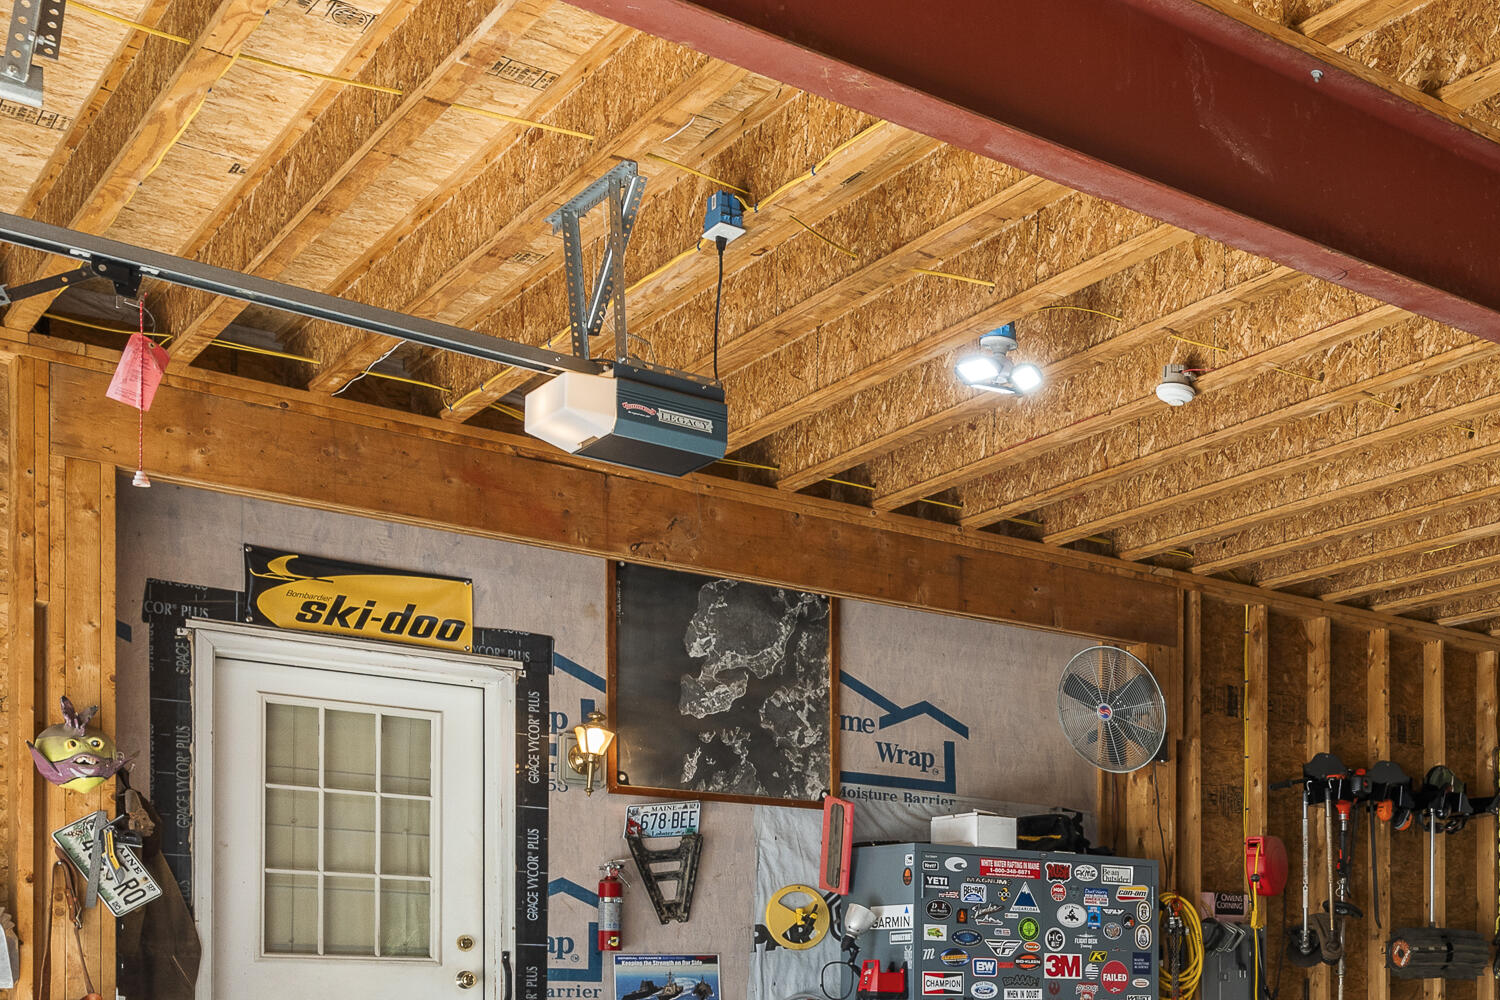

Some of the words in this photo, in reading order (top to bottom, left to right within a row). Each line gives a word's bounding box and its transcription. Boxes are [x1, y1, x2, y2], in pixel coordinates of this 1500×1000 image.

[661, 412, 709, 430] LEGACY
[286, 590, 333, 602] Bombardier
[295, 594, 466, 642] ski-doo
[528, 691, 540, 712] PLUS
[176, 724, 190, 750] PLUS
[528, 754, 540, 784] GRACE
[904, 792, 956, 806] Barrier
[176, 795, 190, 829] GRACE
[528, 828, 540, 850] PLUS
[926, 876, 948, 885] YETI
[1046, 864, 1070, 880] RUSH
[528, 892, 539, 921] GRACE
[1216, 901, 1243, 910] CORNING
[1221, 893, 1242, 902] OWENS
[976, 962, 995, 971] BW
[1046, 955, 1080, 977] 3M
[527, 966, 538, 988] PLUS
